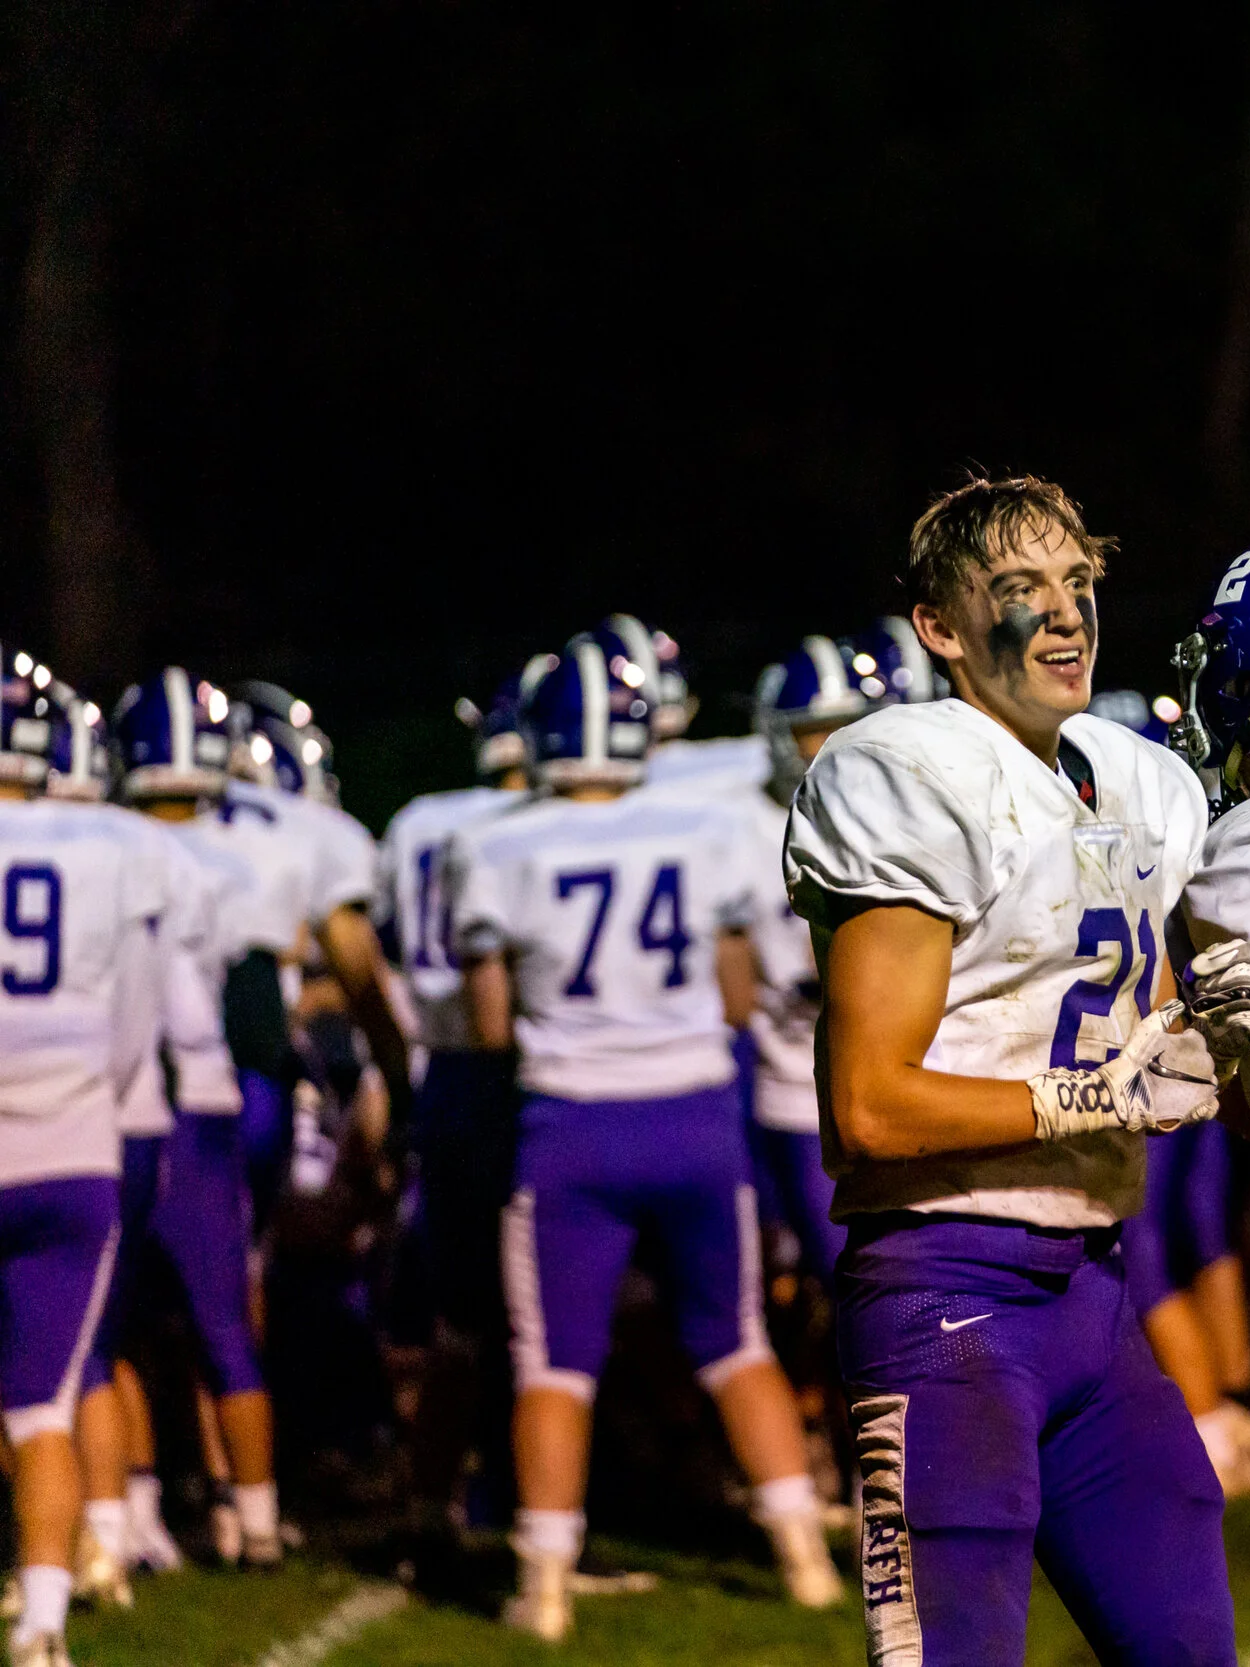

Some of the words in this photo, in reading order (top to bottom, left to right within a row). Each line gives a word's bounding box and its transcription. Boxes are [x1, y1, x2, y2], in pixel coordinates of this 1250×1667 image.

[3, 866, 61, 996] 9
[557, 862, 691, 996] 74
[1049, 907, 1157, 1072] 21
[867, 1518, 903, 1610] RFH
